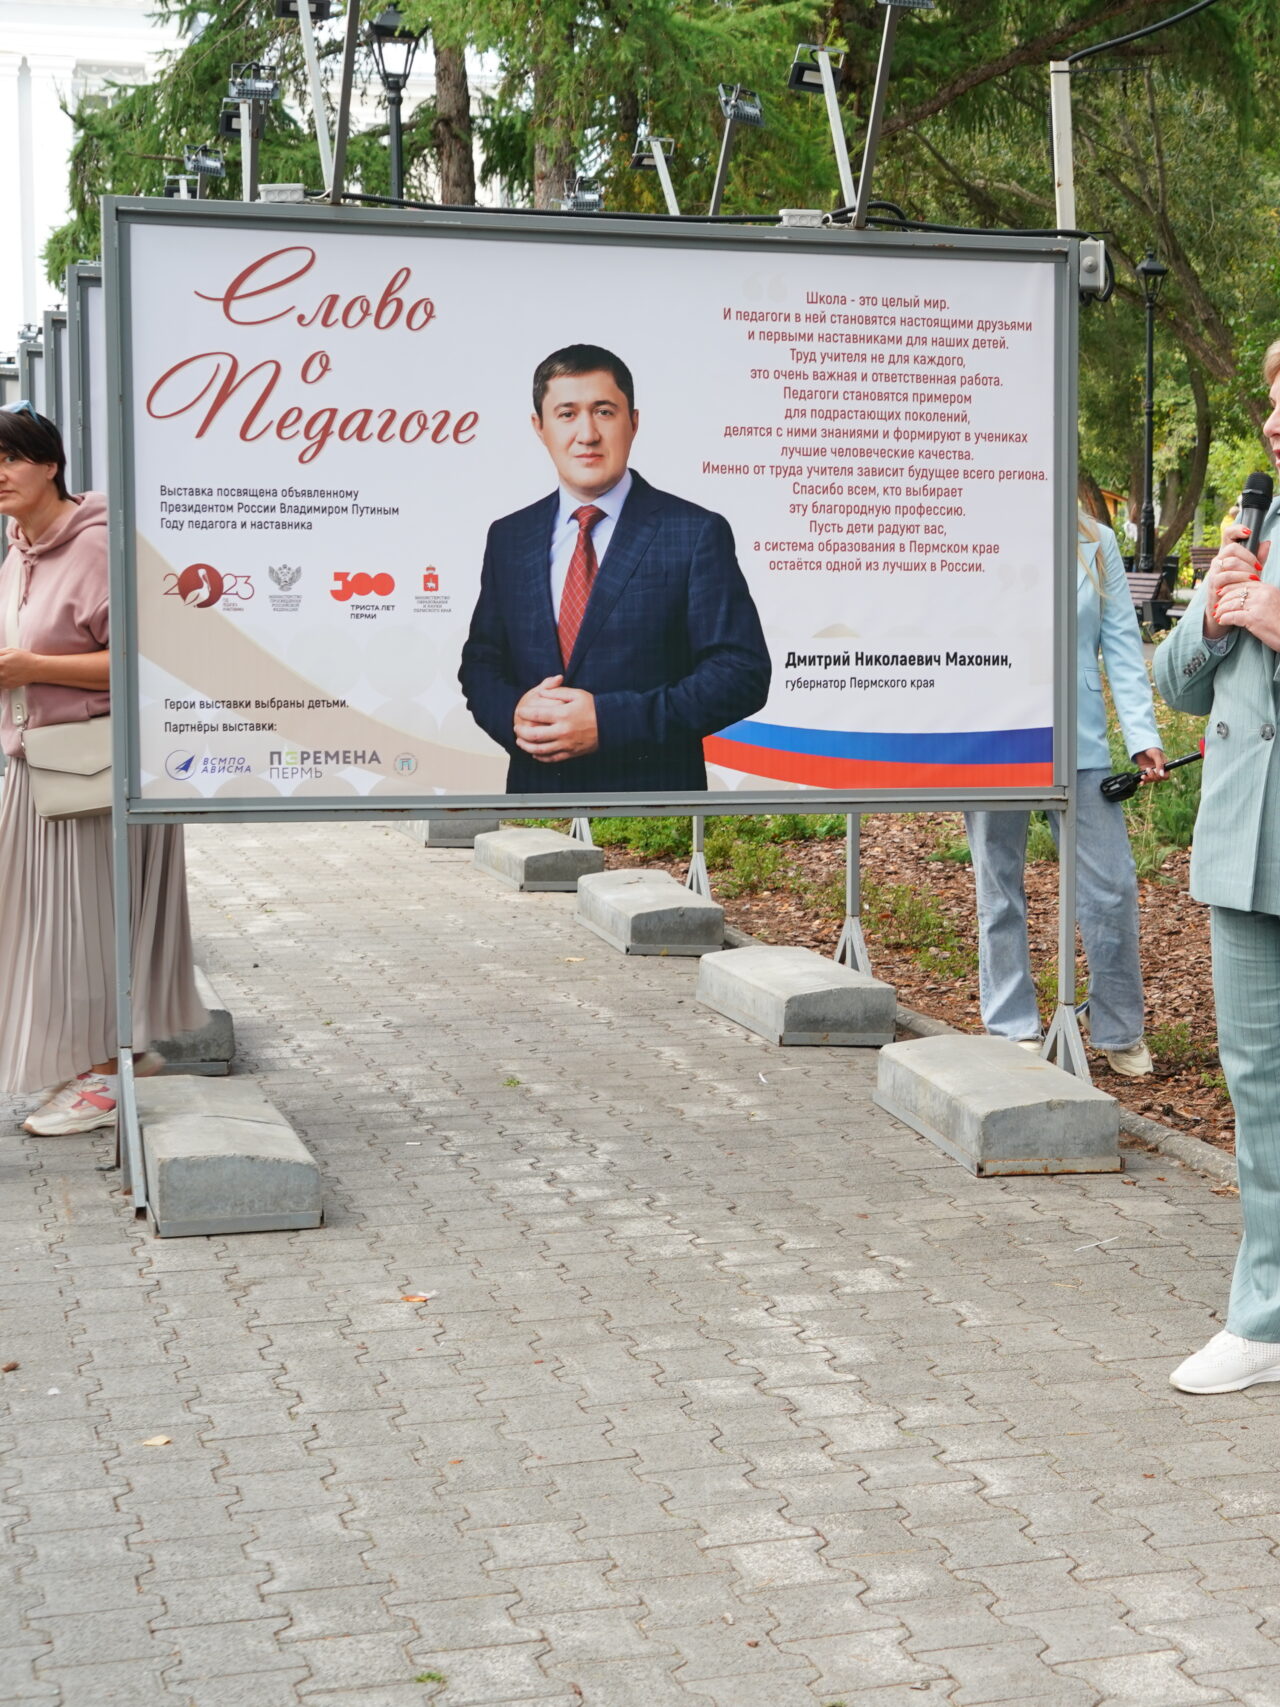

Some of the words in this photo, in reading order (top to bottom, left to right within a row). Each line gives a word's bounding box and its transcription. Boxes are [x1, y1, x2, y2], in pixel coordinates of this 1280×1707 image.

[194, 246, 436, 331] Слово
[807, 292, 846, 305] Школа
[859, 296, 878, 306] это
[882, 296, 920, 308] целый
[924, 299, 949, 312] мир.
[724, 308, 731, 320] И
[736, 311, 790, 322] педагоги
[795, 313, 801, 322] в
[805, 311, 826, 323] ней
[830, 314, 896, 326] становятся
[900, 317, 973, 330] настоящими
[976, 320, 1032, 333] друзьями
[748, 330, 754, 340] и
[759, 331, 813, 344] первыми
[818, 333, 902, 345] наставниками
[906, 336, 927, 347] для
[932, 337, 969, 348] наших
[972, 336, 1008, 350] детей.
[790, 348, 816, 364] Труд
[820, 352, 866, 364] учителя
[871, 354, 884, 364] не
[888, 354, 909, 365] для
[914, 355, 965, 368] каждого,
[300, 350, 332, 384] о
[751, 369, 769, 379] это
[774, 370, 809, 380] очень
[813, 371, 857, 382] важная
[861, 372, 868, 382] и
[872, 372, 956, 384] ответственная
[960, 373, 1003, 388] работа.
[784, 386, 838, 400] Педагоги
[843, 391, 908, 402] становятся
[912, 393, 971, 406] примером
[146, 352, 479, 464] Педагоге
[784, 408, 806, 420] для
[811, 409, 901, 422] подрастающих
[905, 410, 970, 424] поколений,
[724, 426, 772, 438] делятся
[776, 427, 782, 437] с
[787, 428, 817, 438] ними
[821, 428, 878, 439] знаниями
[883, 430, 889, 439] и
[893, 427, 961, 444] формируют
[965, 432, 971, 442] в
[974, 432, 1028, 444] учениках
[781, 446, 827, 459] лучшие
[830, 448, 914, 459] человеческие
[918, 450, 974, 460] качества.
[703, 462, 749, 474] Именно
[754, 465, 766, 474] от
[769, 465, 802, 478] труда
[807, 466, 853, 479] учителя
[857, 467, 904, 477] зависит
[908, 465, 959, 481] будущее
[963, 470, 994, 479] всего
[999, 470, 1047, 482] региона.
[160, 485, 213, 496] Выставка
[217, 488, 278, 498] посвящена
[281, 486, 358, 501] объявленному
[793, 482, 843, 495] Спасибо
[848, 486, 879, 498] всем,
[883, 486, 902, 496] кто
[906, 484, 963, 500] выбирает
[161, 502, 233, 514] Президентом
[238, 502, 276, 513] России
[280, 503, 348, 516] Владимиром
[352, 504, 399, 517] Путиным
[790, 504, 808, 516] эту
[812, 501, 891, 517] благородную
[895, 503, 965, 518] профессию.
[161, 518, 184, 531] Году
[188, 520, 237, 530] педагога
[250, 521, 312, 530] наставника
[810, 520, 843, 536] Пусть
[846, 524, 874, 534] дети
[878, 524, 920, 536] радуют
[924, 524, 946, 536] вас,
[754, 541, 760, 551] а
[765, 542, 814, 552] система
[818, 539, 895, 554] образования
[900, 543, 906, 552] в
[910, 540, 968, 556] Пермском
[972, 544, 999, 556] крае
[770, 558, 822, 570] остаётся
[826, 558, 861, 572] одной
[866, 561, 879, 571] из
[882, 562, 926, 574] лучших
[930, 562, 936, 572] в
[941, 560, 984, 572] России.
[330, 572, 395, 602] 300
[350, 604, 380, 612] ТРИСТА
[381, 604, 396, 612] ЛЕТ
[785, 651, 850, 670] Дмитрий
[856, 652, 940, 666] Николаевич
[946, 652, 1011, 668] Махонин,
[786, 677, 846, 691] губернатор
[850, 677, 907, 690] Пермского
[910, 679, 934, 690] края
[165, 698, 196, 712] Герои
[200, 700, 251, 709] выставки
[255, 697, 304, 710] выбраны
[308, 700, 348, 710] детьми.
[164, 721, 218, 734] Партнёры
[222, 723, 277, 732] выставки:
[200, 765, 252, 774] АВИСМА
[202, 756, 246, 766] ВСМПО
[269, 766, 323, 780] ПЕРМЬ
